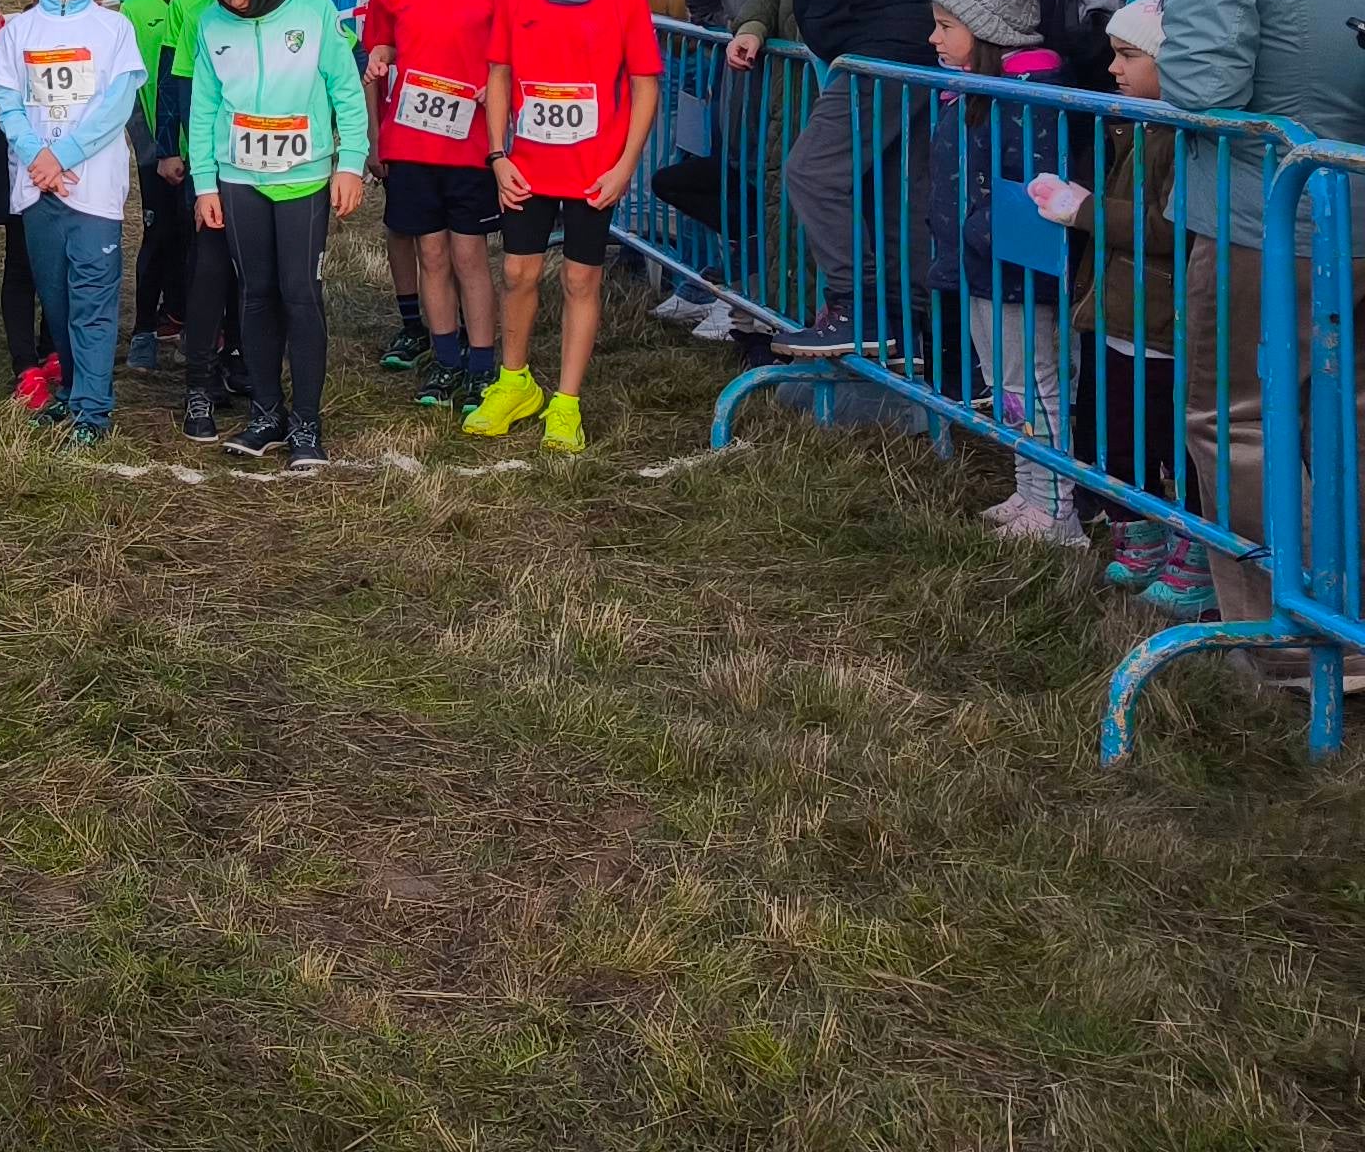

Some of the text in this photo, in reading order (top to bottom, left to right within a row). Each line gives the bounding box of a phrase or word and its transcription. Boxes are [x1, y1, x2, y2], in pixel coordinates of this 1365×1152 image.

[41, 67, 73, 89] 19
[414, 91, 460, 122] 381
[533, 102, 584, 128] 380
[240, 132, 307, 156] 1170
